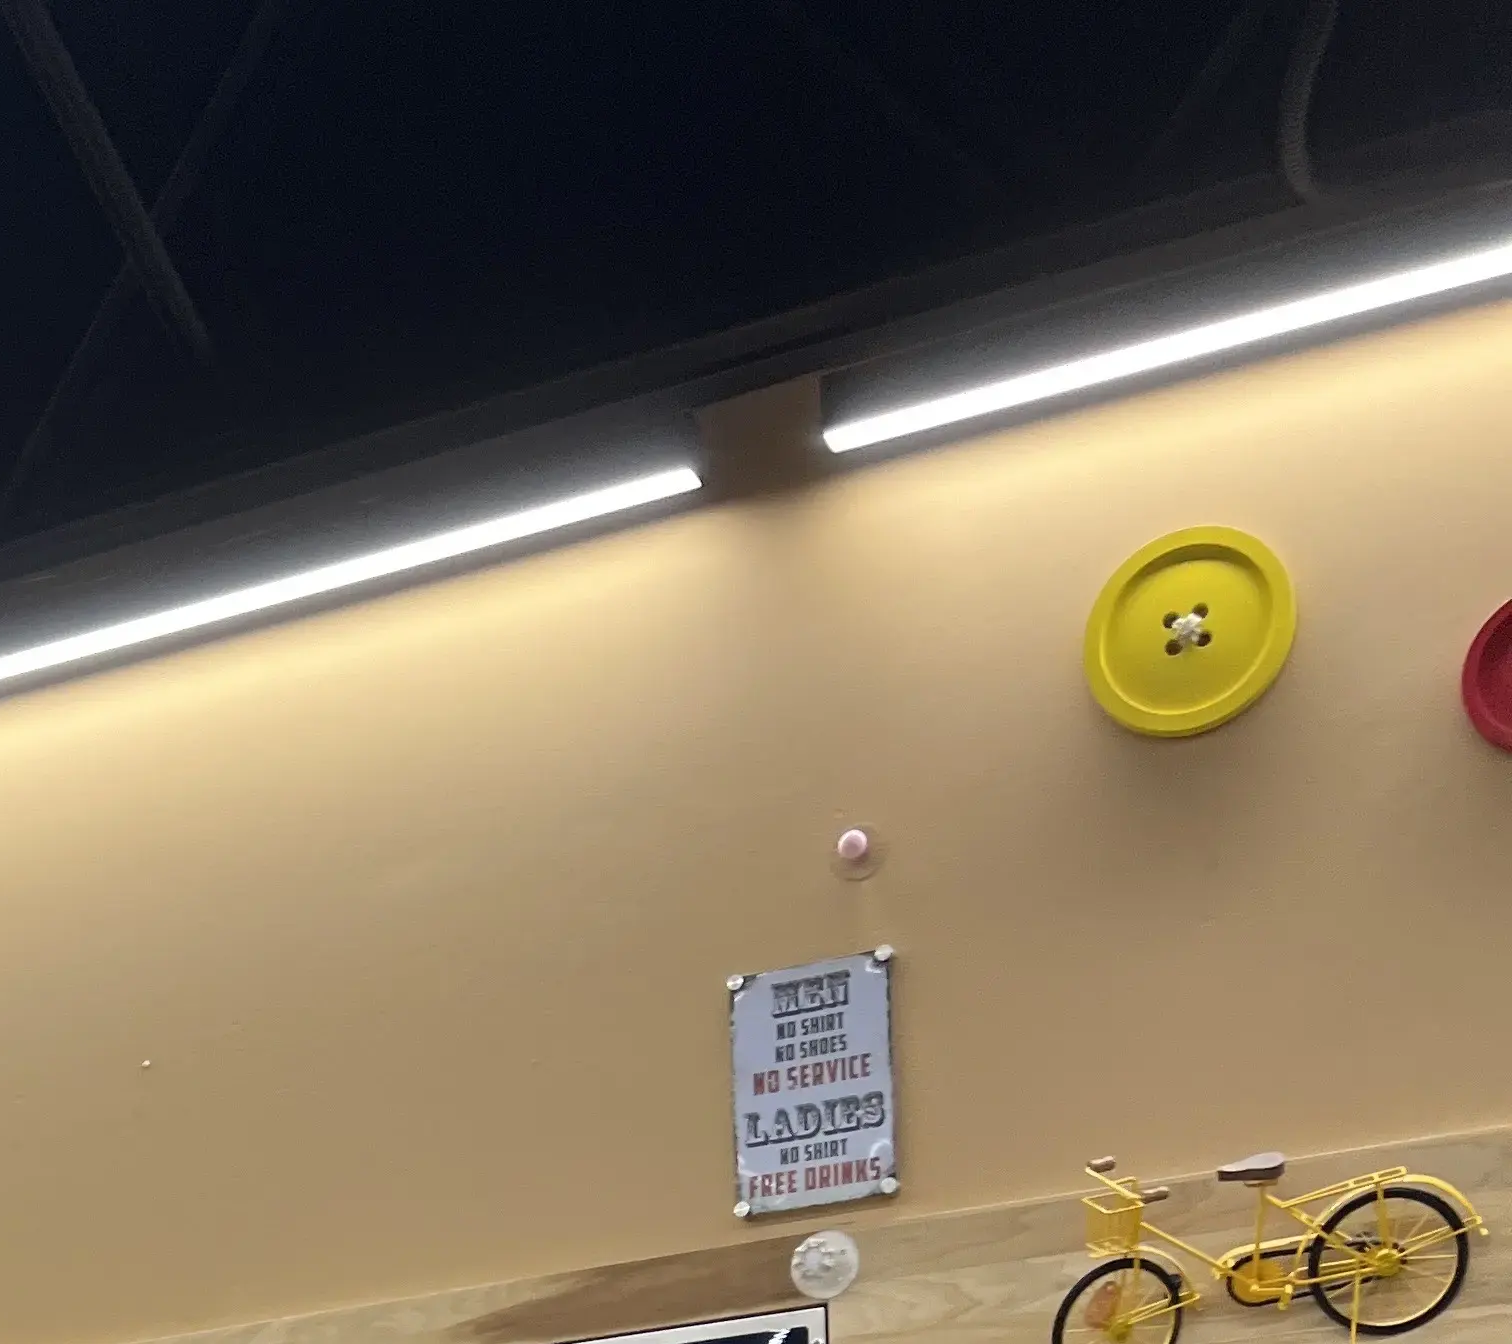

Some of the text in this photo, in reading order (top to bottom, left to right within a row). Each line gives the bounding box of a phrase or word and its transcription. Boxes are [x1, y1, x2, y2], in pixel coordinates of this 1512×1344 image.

[771, 970, 851, 1018] MEN
[776, 1012, 845, 1040] NO SHIRT
[775, 1034, 848, 1063] NO SHOES
[753, 1053, 871, 1096] NO SERVICE
[743, 1090, 886, 1148] LADIES
[780, 1138, 848, 1165] NO SHIRT
[748, 1156, 881, 1200] FREE DRINKS
